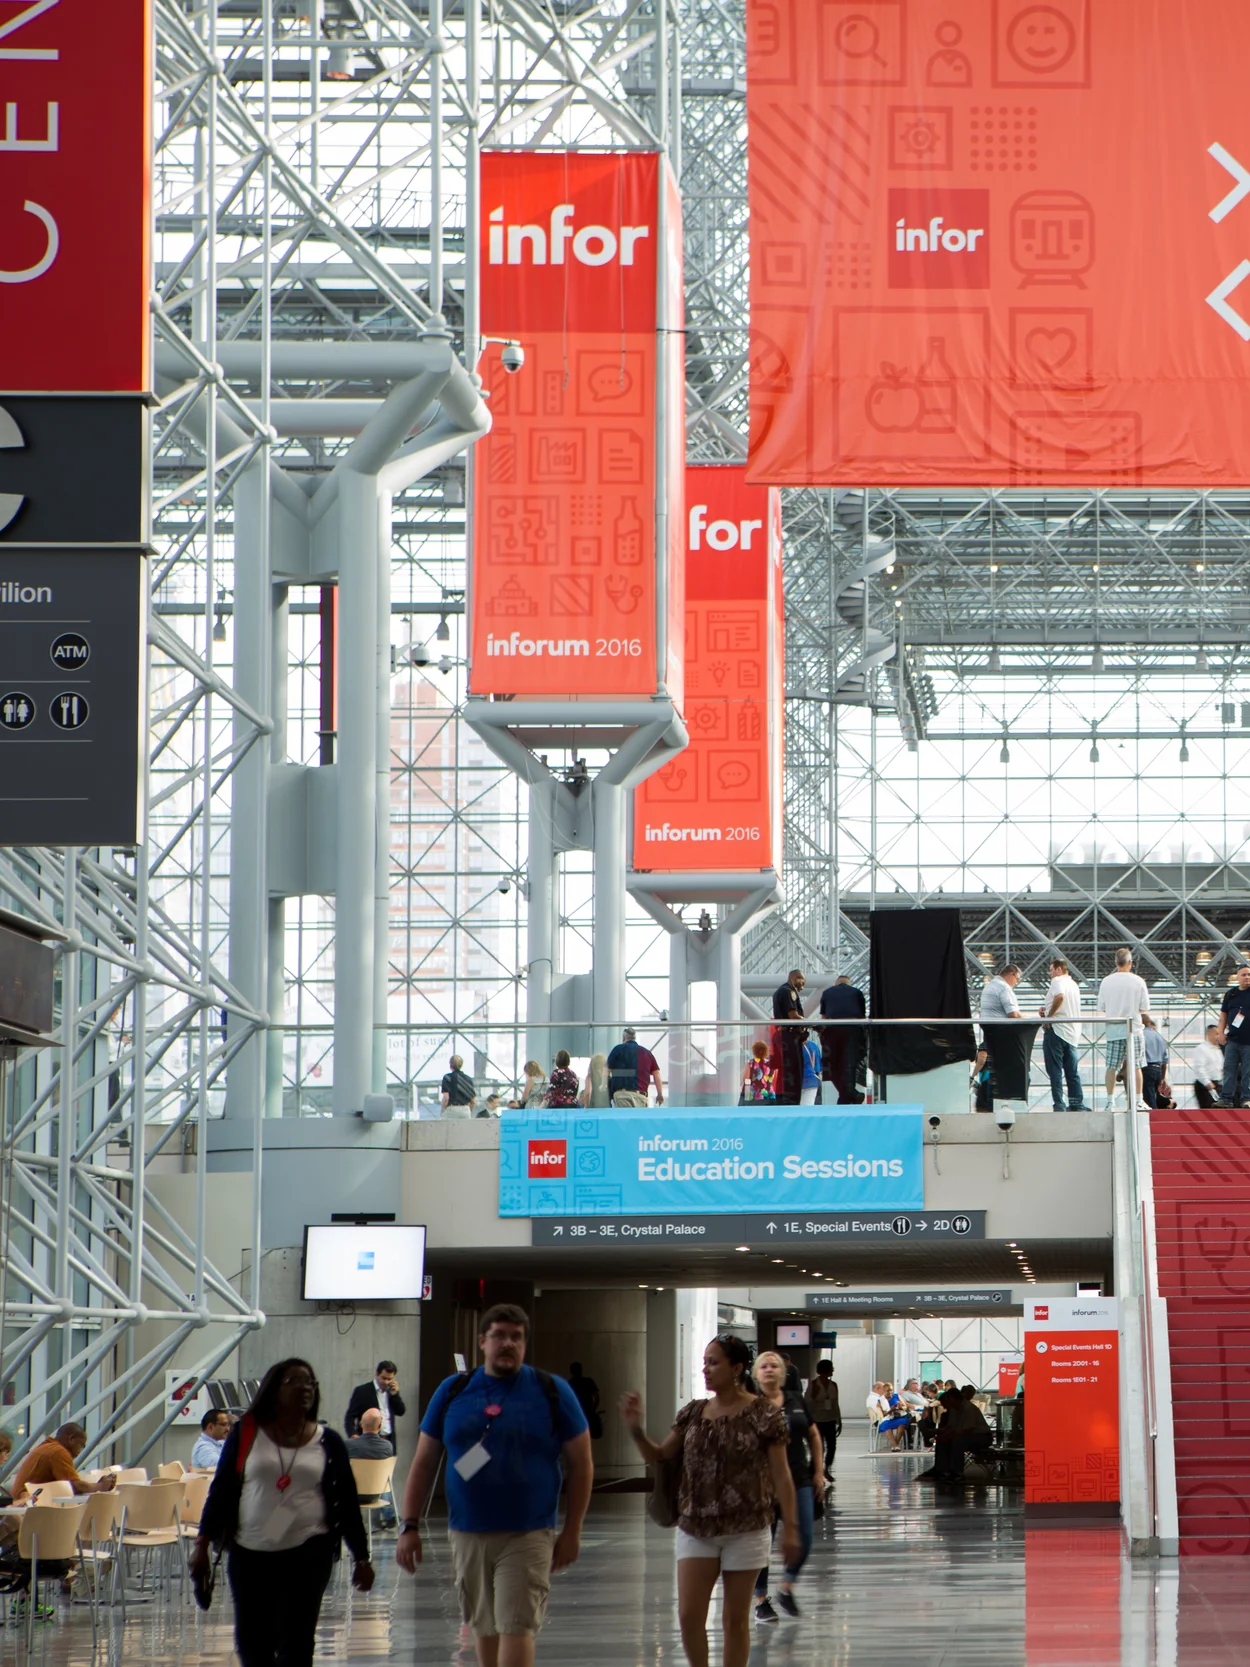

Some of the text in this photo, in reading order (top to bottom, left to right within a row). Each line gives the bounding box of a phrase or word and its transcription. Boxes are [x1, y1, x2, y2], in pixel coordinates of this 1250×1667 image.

[489, 204, 648, 266] infor
[896, 217, 984, 252] infor
[689, 505, 762, 551] for
[0, 582, 52, 603] ilion
[54, 645, 87, 658] ATM
[487, 632, 642, 657] inforum 2016
[645, 822, 760, 841] inforum 2016
[639, 1135, 743, 1151] inforum 2016
[530, 1150, 564, 1166] infor
[638, 1154, 904, 1182] Education Sessions
[570, 1225, 586, 1236] 3B
[600, 1225, 618, 1237] 3E,
[621, 1224, 662, 1238] Crystal
[666, 1224, 705, 1235] Palace
[784, 1221, 891, 1235] 1E, Special Events
[933, 1220, 950, 1231] 2D
[848, 1296, 871, 1304] Meeting
